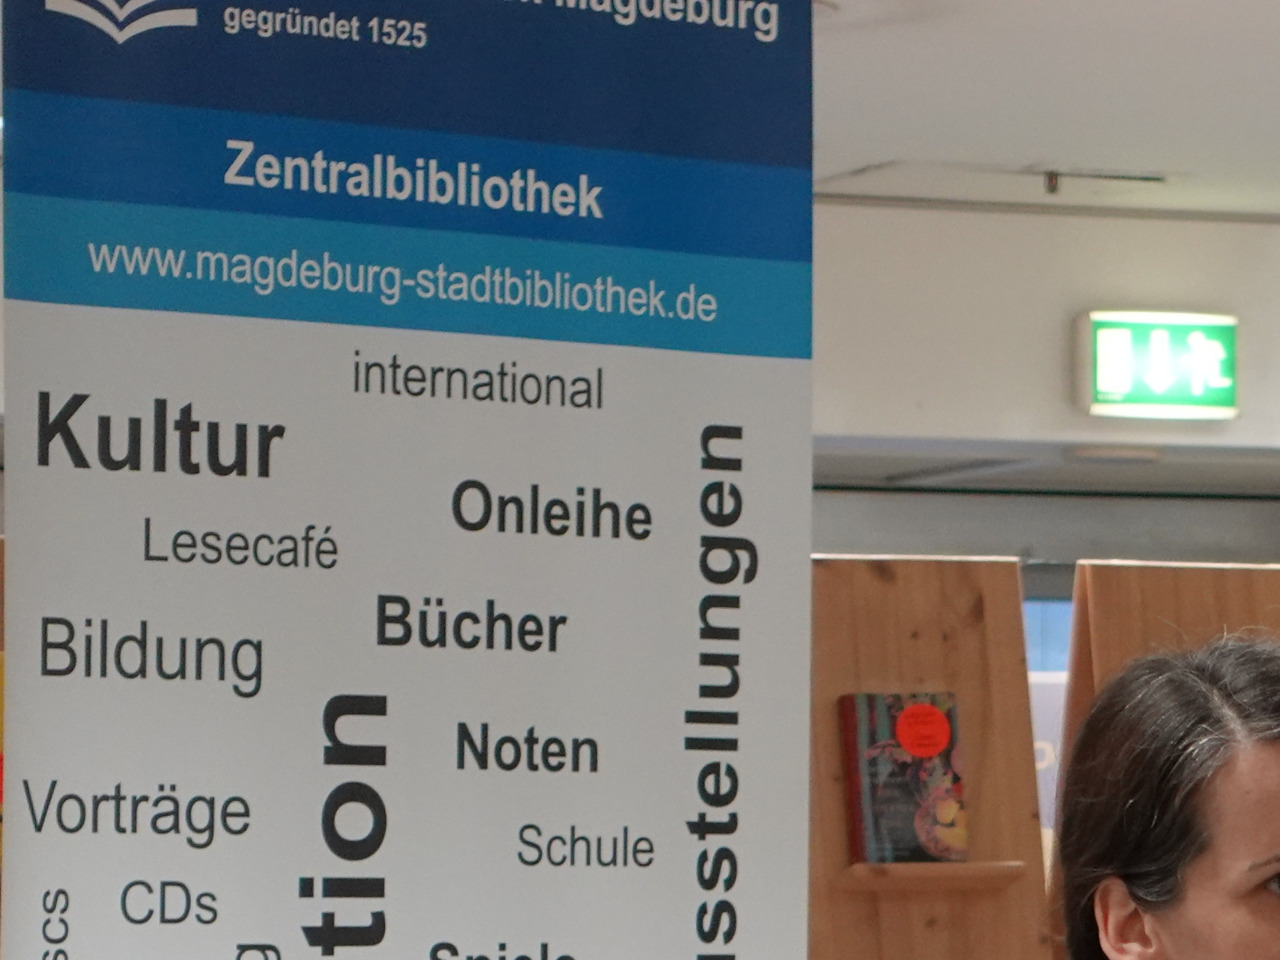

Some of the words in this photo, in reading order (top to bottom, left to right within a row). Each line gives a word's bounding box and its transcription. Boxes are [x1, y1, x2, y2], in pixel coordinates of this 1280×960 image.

[223, 6, 361, 42] gegründet
[368, 17, 428, 49] 1525
[555, 0, 779, 43] gdeburg
[224, 139, 603, 219] Zentralbibliothek
[88, 242, 718, 322] www.magdeburg-stadtbibliothek.de
[353, 350, 603, 410] international
[37, 391, 286, 479] Kultur
[451, 480, 653, 541] Onleihe
[144, 518, 339, 570] Lesecafé
[377, 594, 568, 653] Bücher
[40, 616, 263, 699] Bildung
[456, 722, 599, 773] Noten
[22, 780, 251, 850] Vorträge
[517, 824, 655, 868] Schule
[120, 879, 218, 925] CDs
